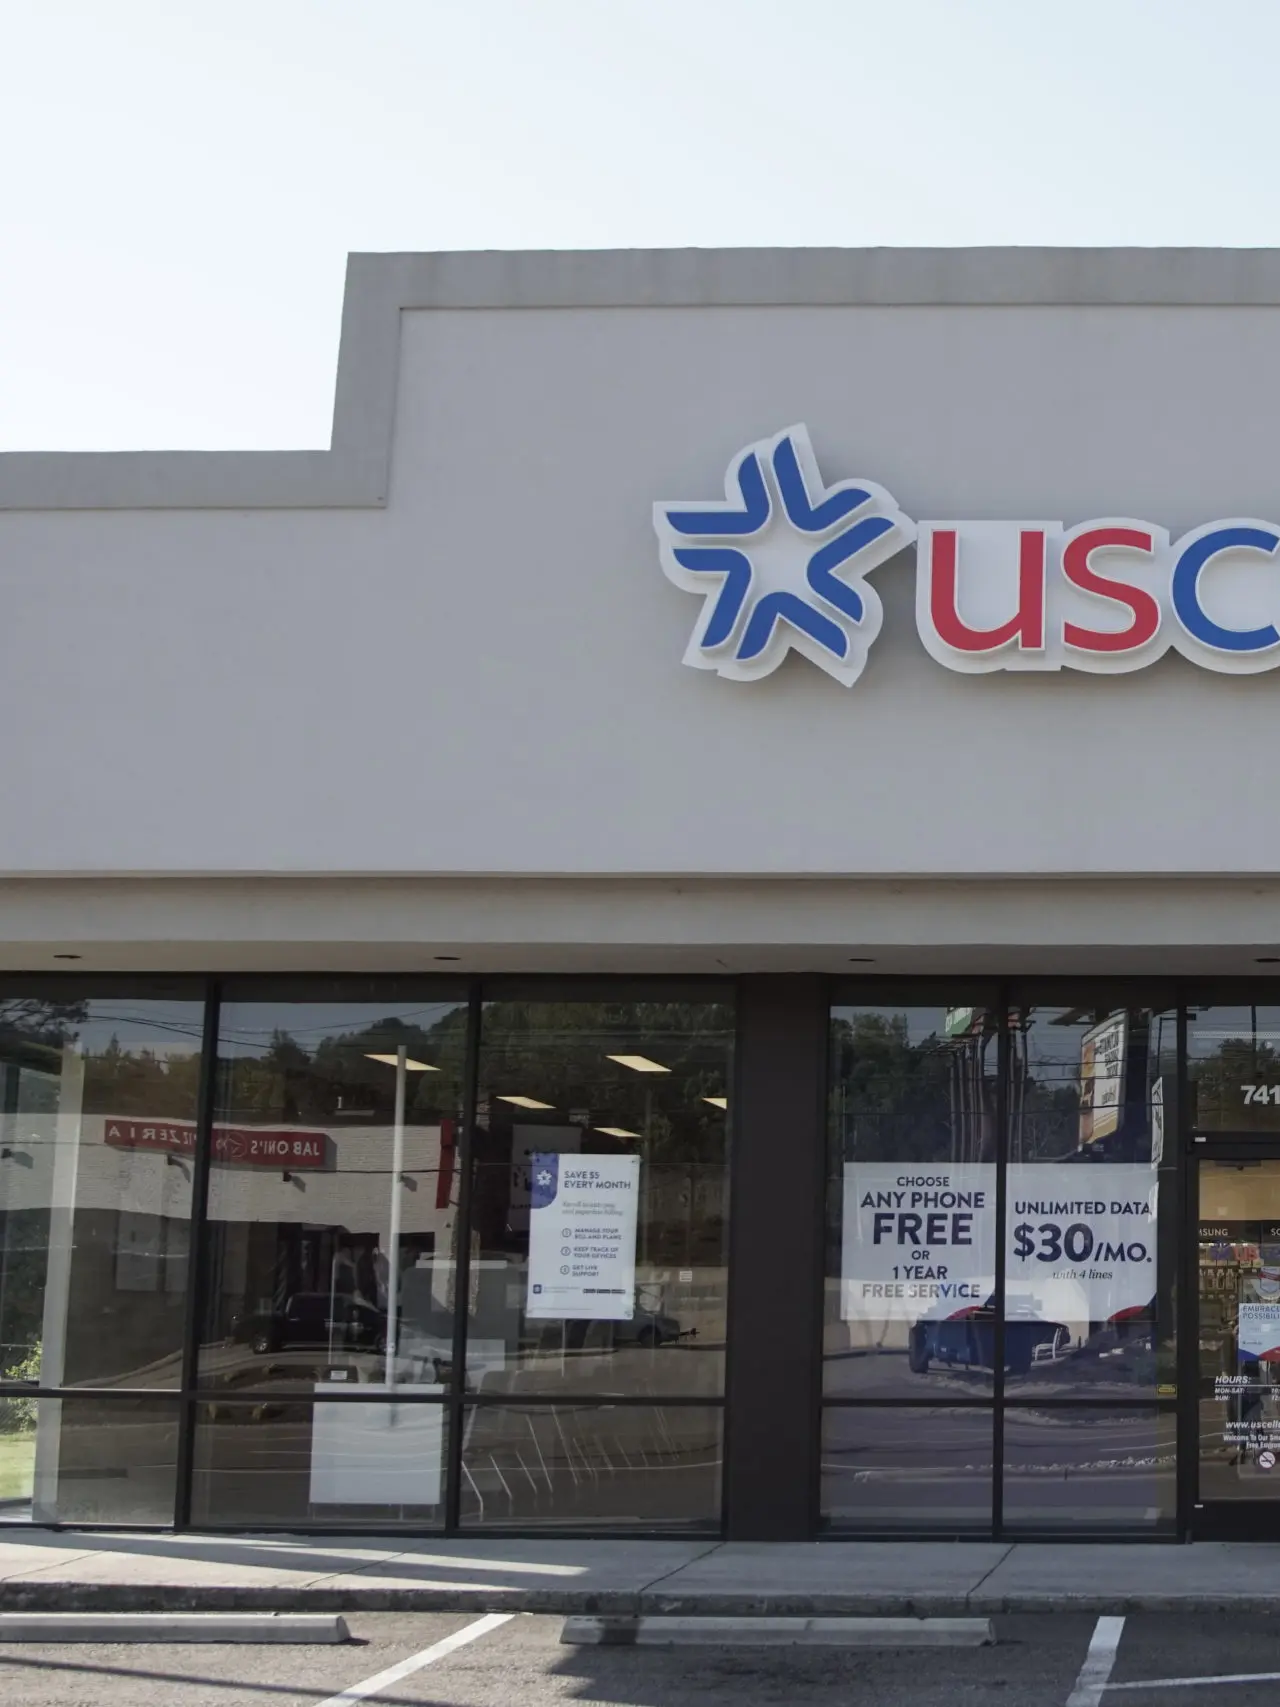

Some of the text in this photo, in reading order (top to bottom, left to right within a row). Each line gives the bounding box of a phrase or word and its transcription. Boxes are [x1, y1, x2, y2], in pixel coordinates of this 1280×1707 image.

[564, 1170, 600, 1180] SAVE $5
[564, 1180, 631, 1190] EVERY MONTH
[896, 1176, 950, 1187] CHOOSE
[860, 1191, 985, 1209] ANY PHONE
[1015, 1201, 1152, 1215] UNLIMITED DATA
[873, 1212, 973, 1245] FREE
[911, 1250, 930, 1261] OR
[892, 1266, 948, 1280] 1 YEAR
[1052, 1269, 1113, 1280] with 4 lines
[862, 1283, 981, 1299] FREE SERVICE
[1242, 1305, 1280, 1313] EMBRACE
[1214, 1375, 1252, 1384] HOURS:
